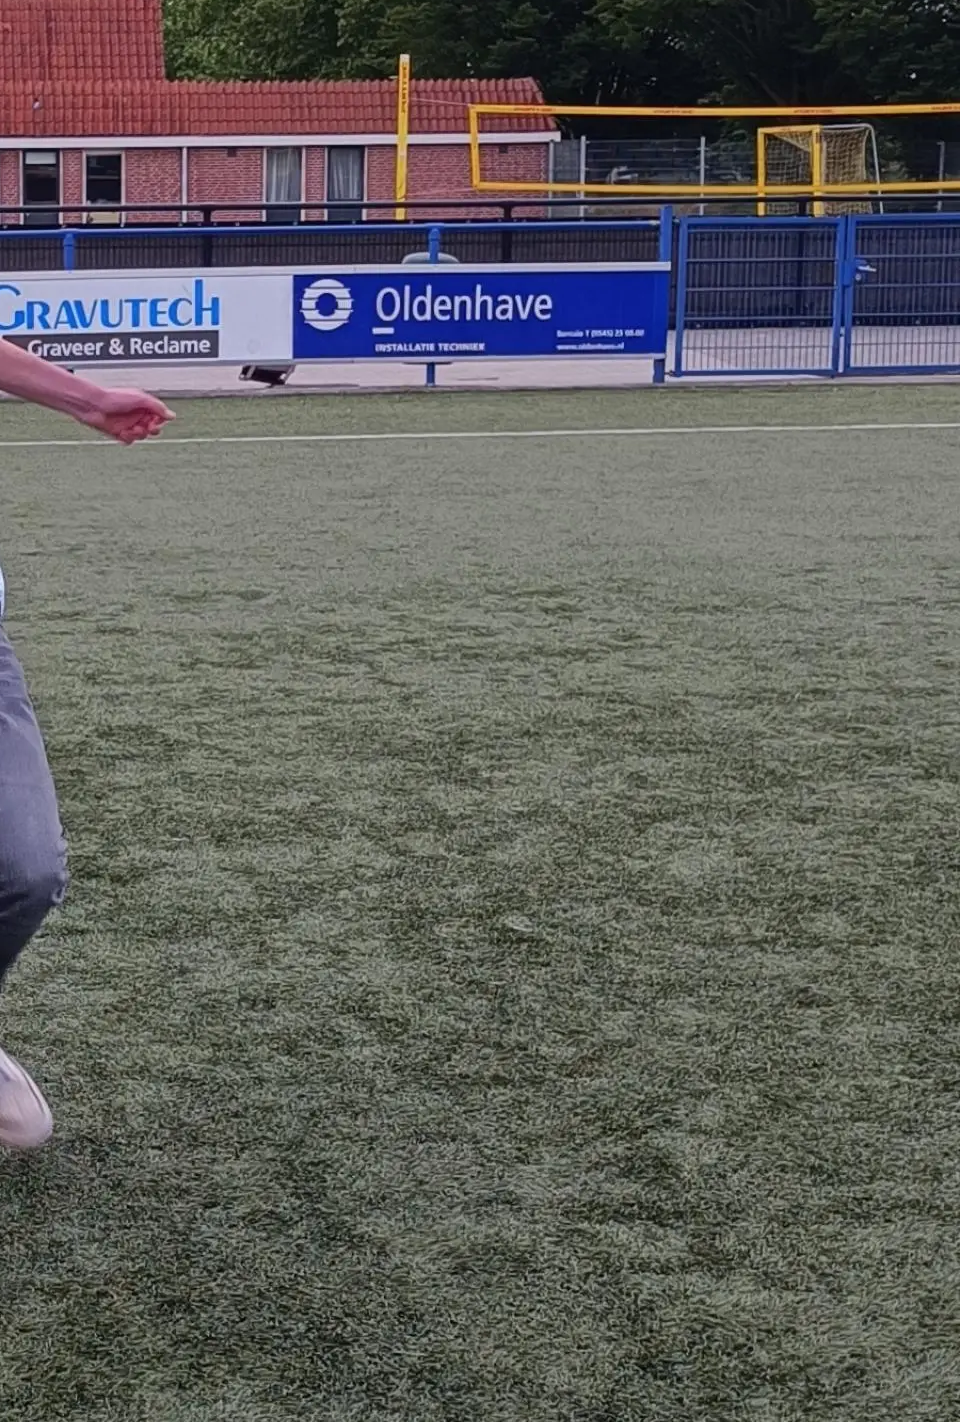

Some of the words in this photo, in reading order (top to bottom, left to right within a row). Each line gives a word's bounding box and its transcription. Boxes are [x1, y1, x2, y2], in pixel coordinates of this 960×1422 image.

[375, 284, 553, 322] Oldenhave
[27, 340, 102, 358] Graveer
[109, 338, 125, 356] &
[130, 337, 211, 355] Reclame
[375, 343, 435, 353] INSTALLATIE
[438, 342, 486, 352] TECHNIEK
